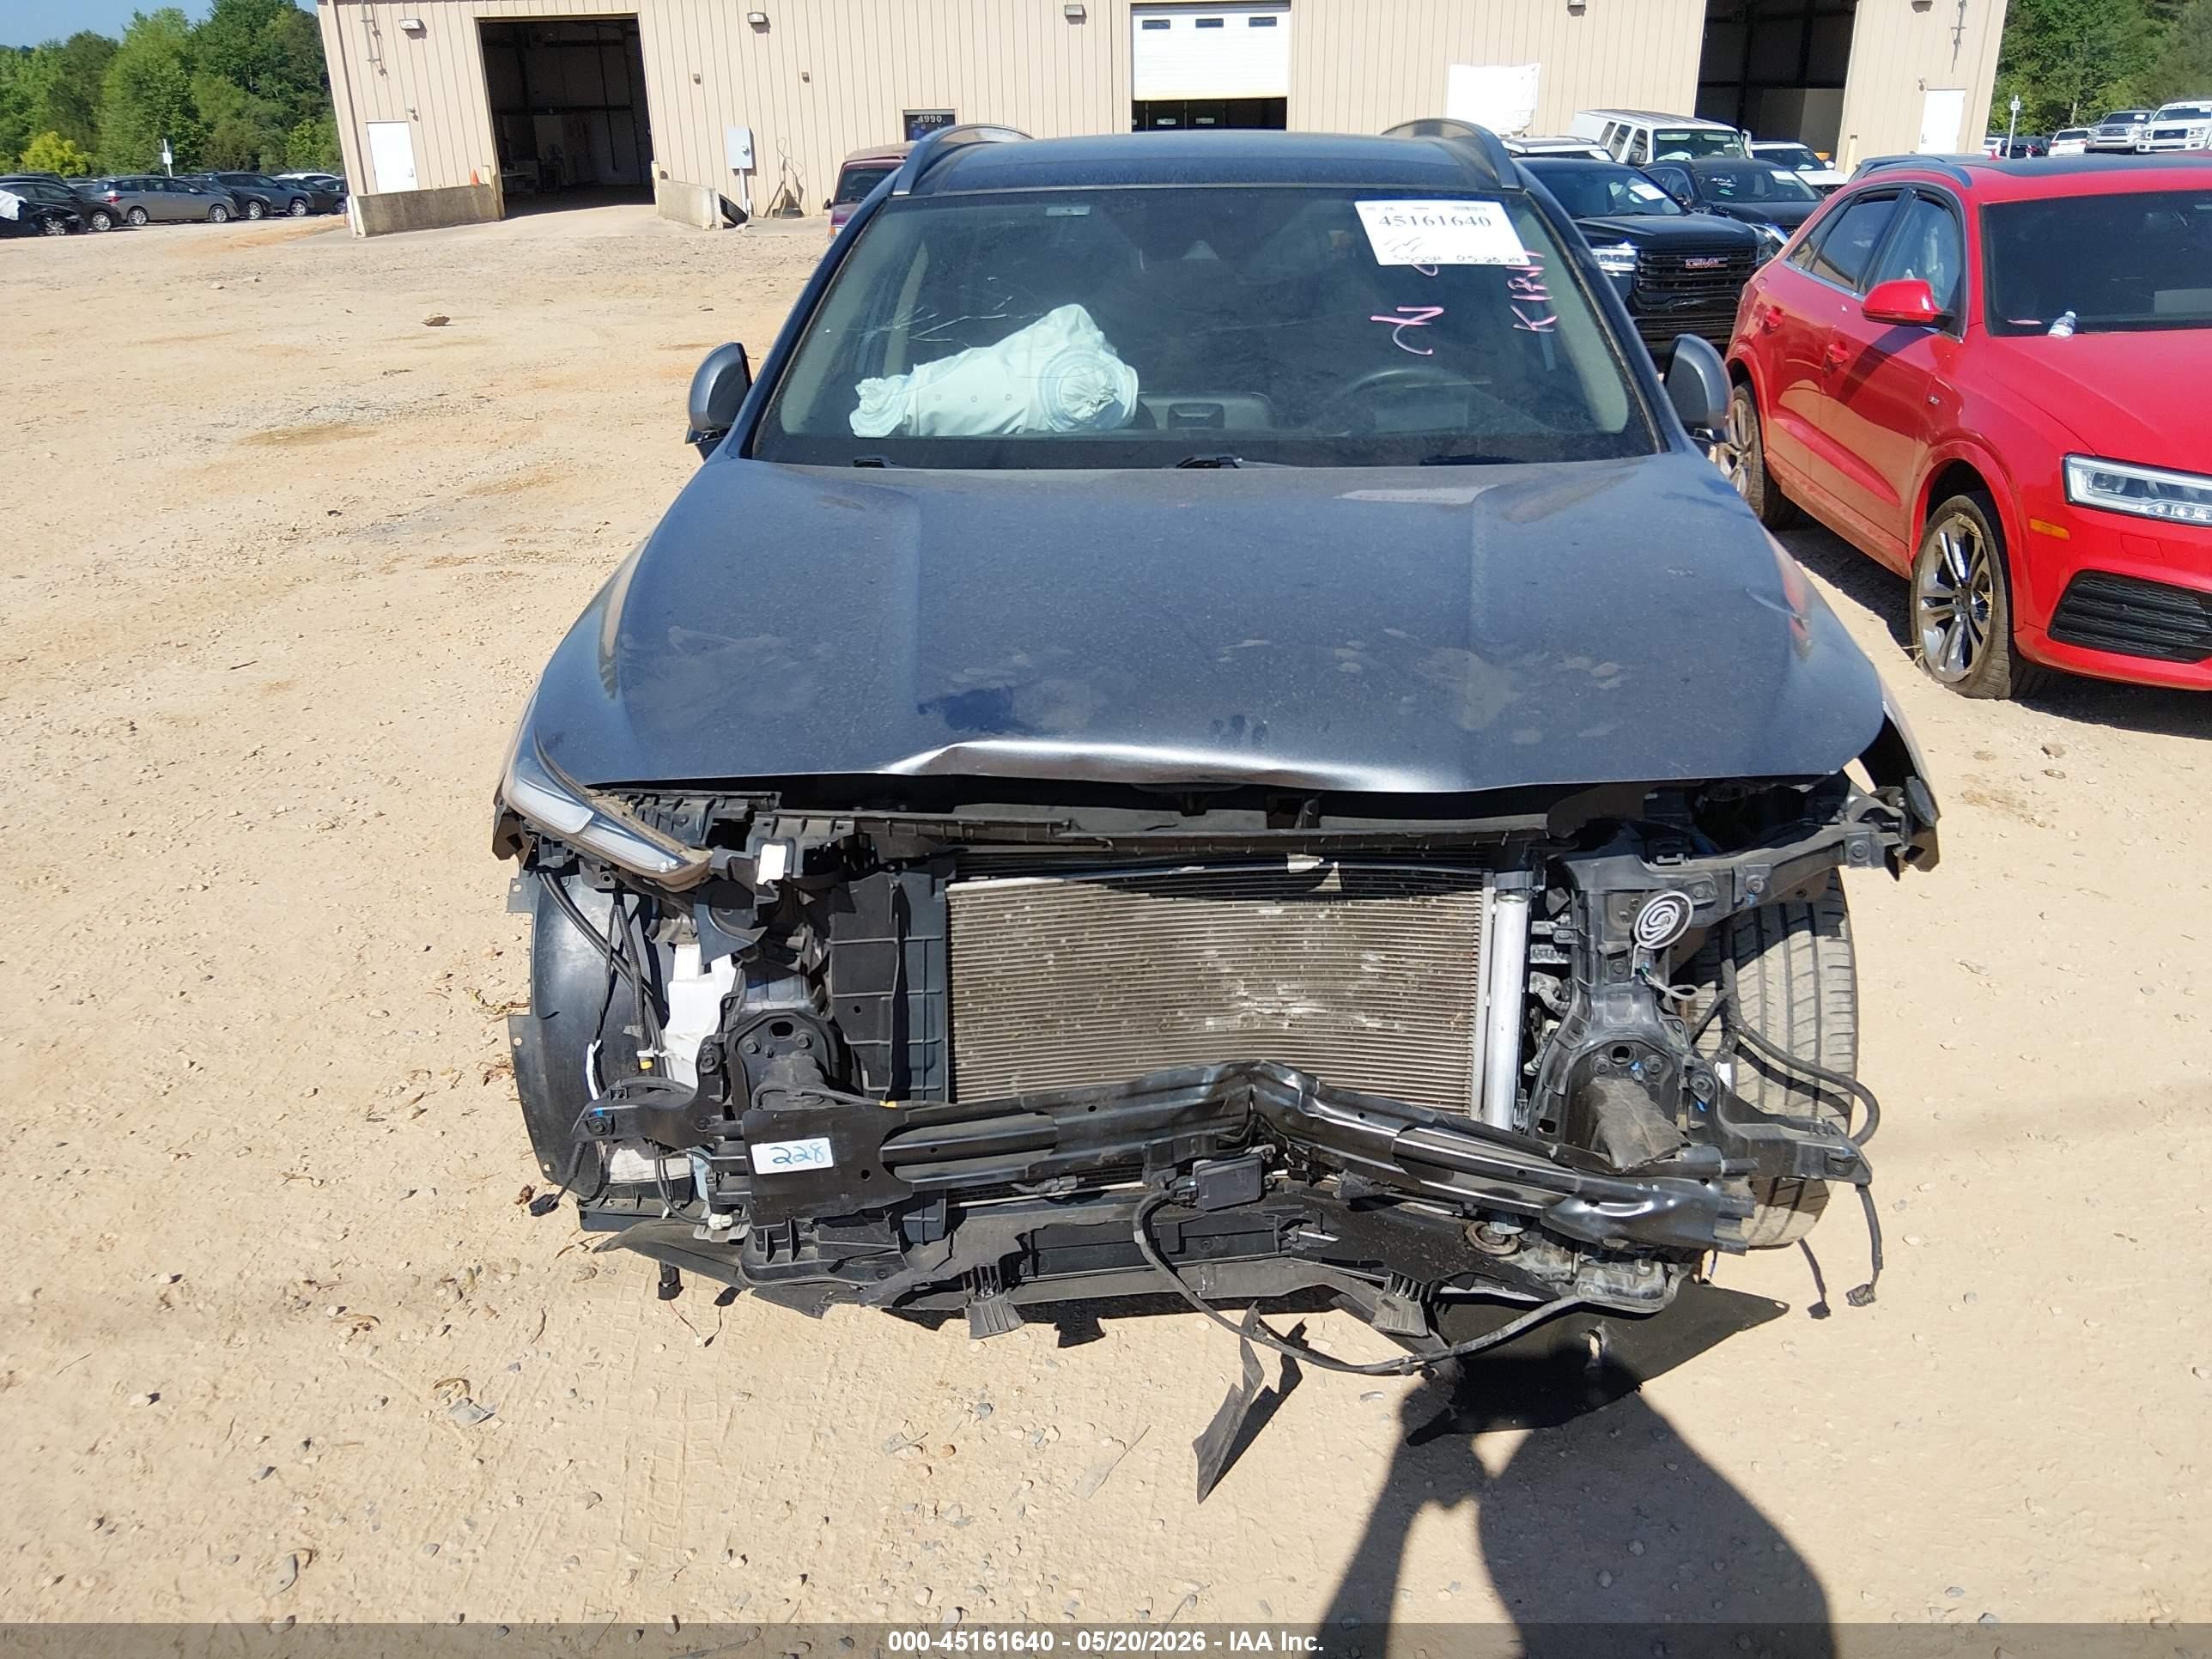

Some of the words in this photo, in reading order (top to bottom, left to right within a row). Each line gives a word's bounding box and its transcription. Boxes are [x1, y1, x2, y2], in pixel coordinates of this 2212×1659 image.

[1378, 215, 1492, 227] 45161640
[1685, 258, 1729, 269] GMC
[769, 1142, 824, 1164] 228
